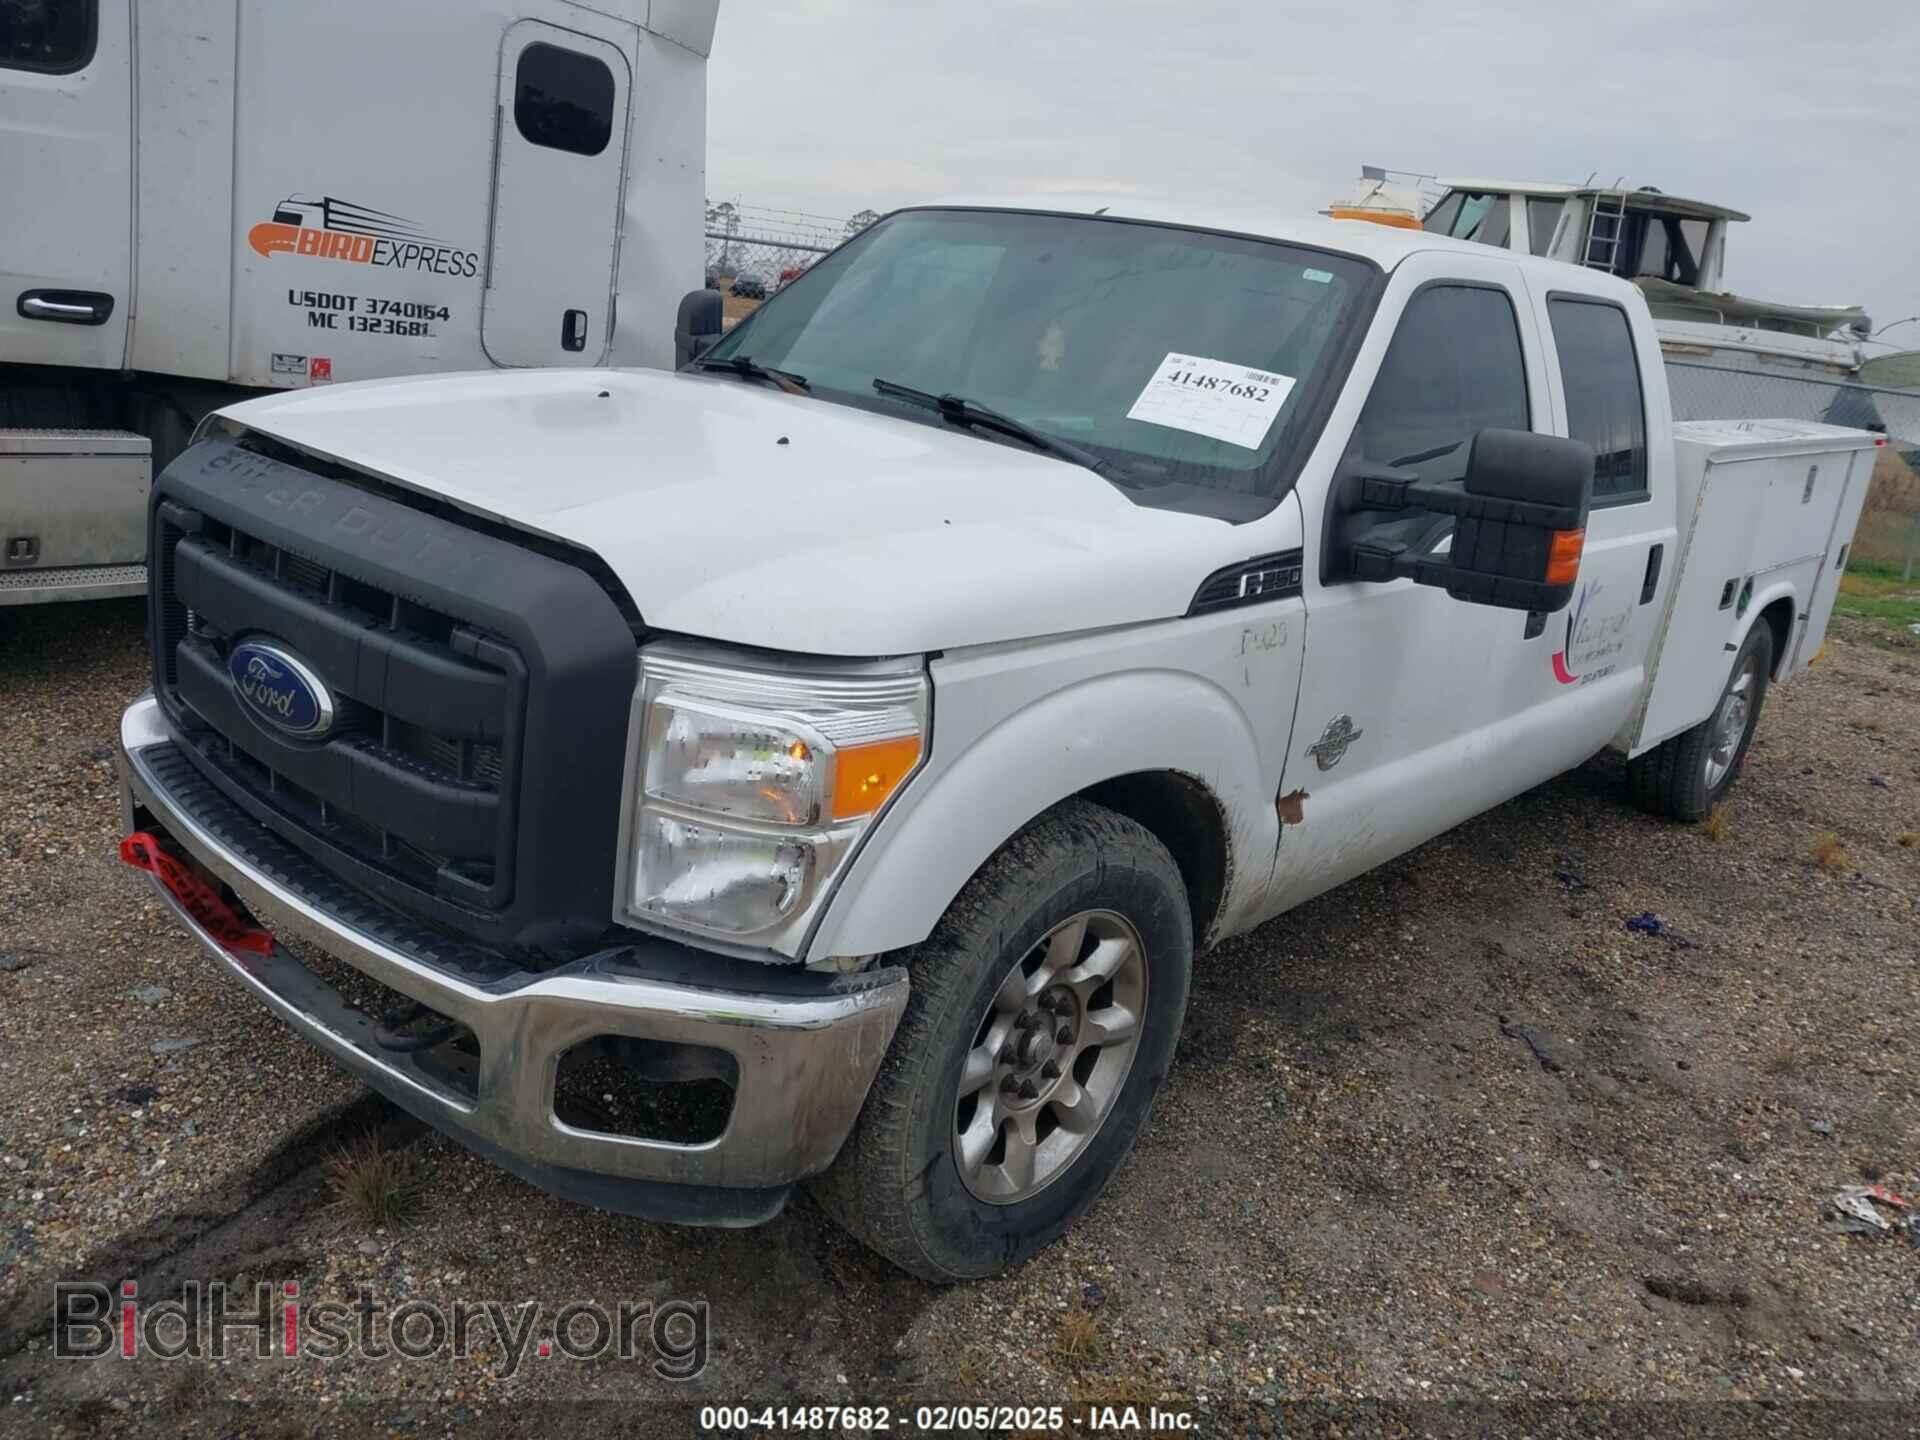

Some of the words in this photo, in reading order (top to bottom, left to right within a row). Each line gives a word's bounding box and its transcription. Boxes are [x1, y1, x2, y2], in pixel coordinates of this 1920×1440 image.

[288, 289, 358, 312] USDOT
[308, 311, 338, 329] MC
[348, 316, 429, 337] 1323681
[1168, 369, 1270, 403] 41487682
[242, 657, 296, 718] Ford
